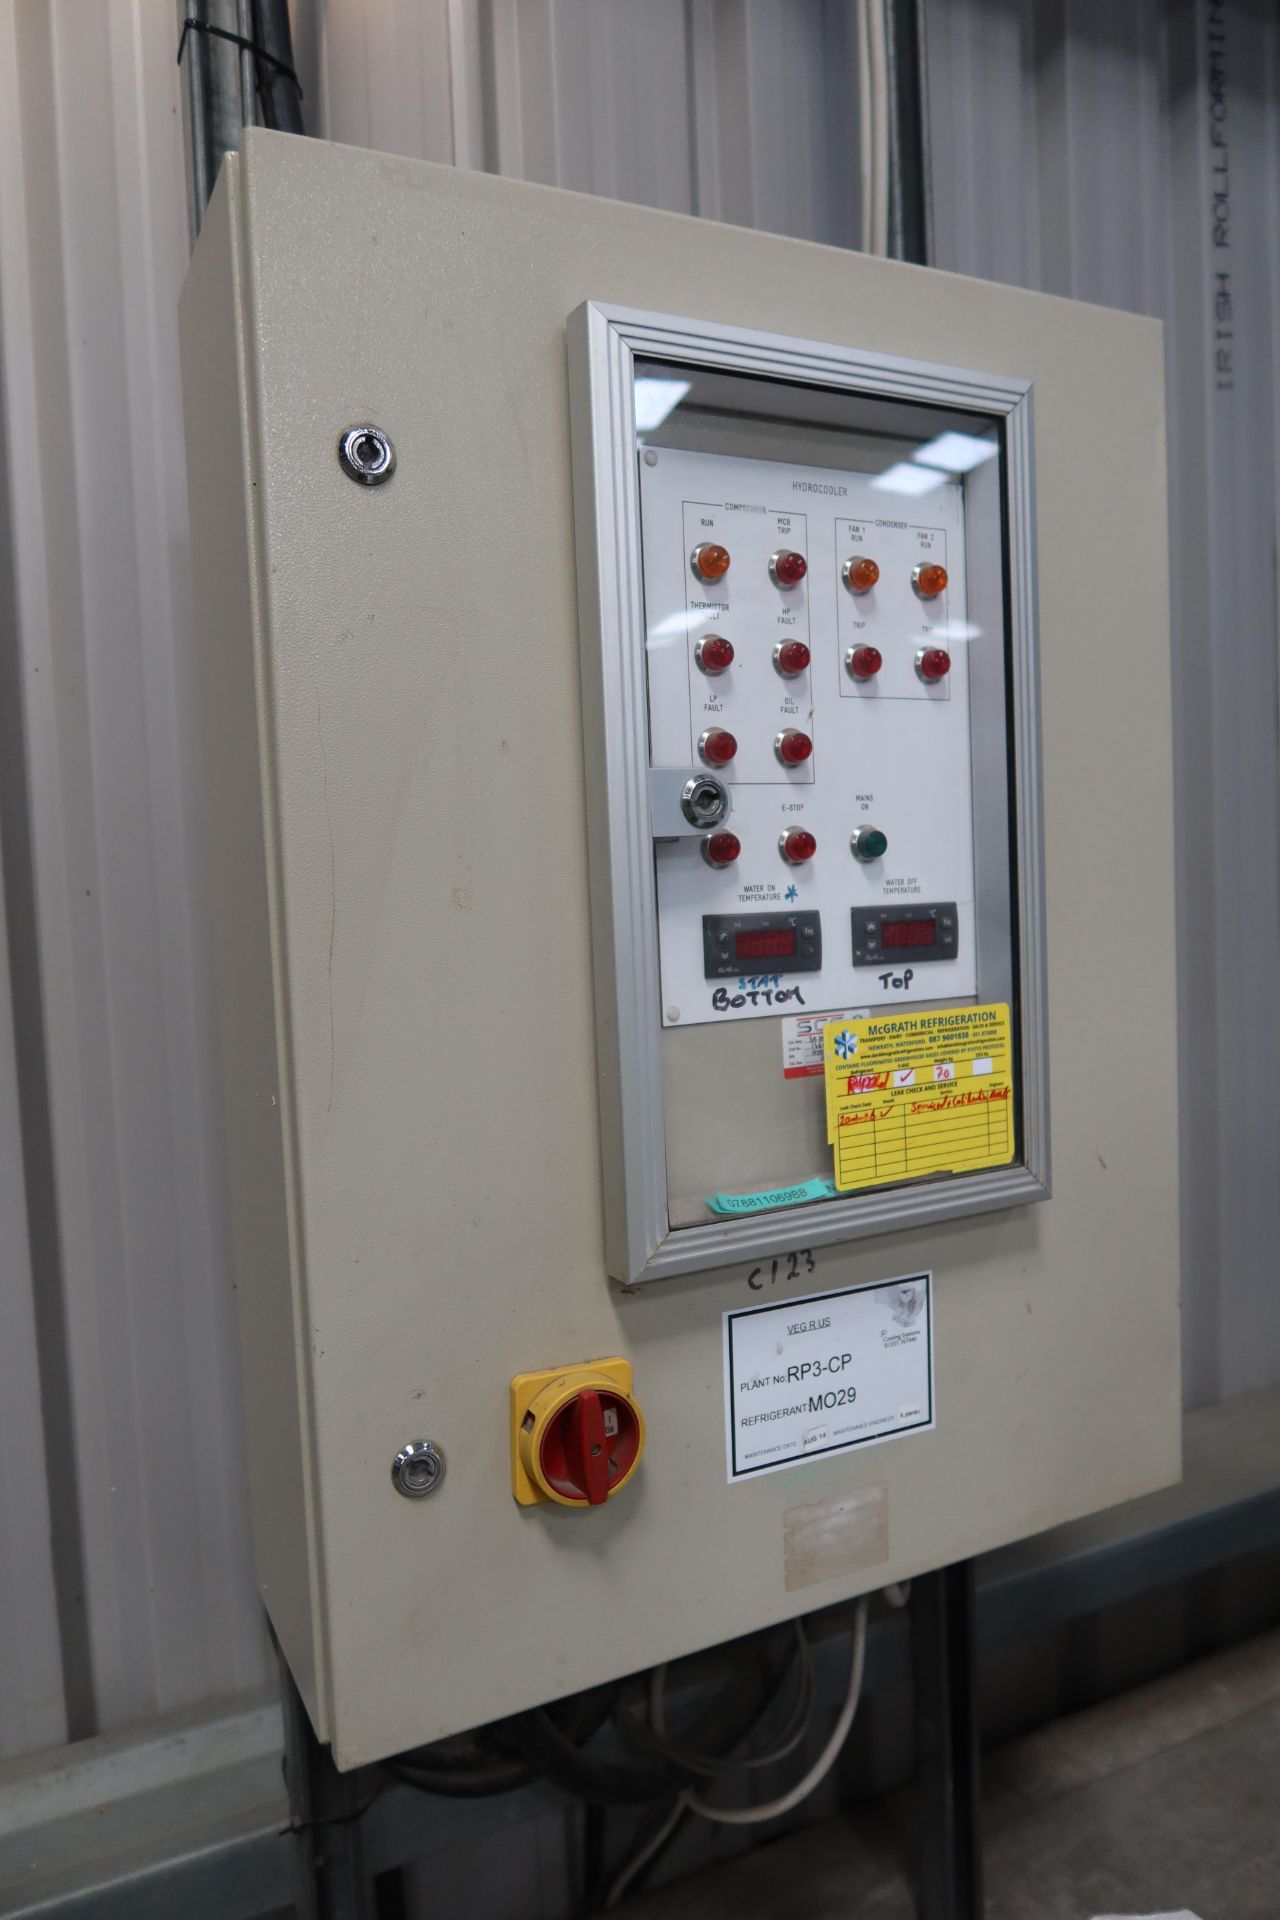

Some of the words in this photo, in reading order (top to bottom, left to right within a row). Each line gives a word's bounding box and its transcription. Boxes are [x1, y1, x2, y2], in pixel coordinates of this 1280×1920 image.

[1214, 271, 1233, 391] IRISH
[792, 480, 848, 497] HYDROCOOLER
[701, 518, 714, 527] RUN
[777, 517, 791, 526] MCB
[875, 518, 908, 529] CONDENSER
[777, 526, 791, 535] TRIP
[848, 524, 860, 533] FAN
[851, 534, 863, 542] RUN
[917, 532, 929, 540] FAN
[920, 541, 932, 549] RUN
[782, 607, 791, 616] HP
[777, 616, 796, 625] FAULT
[853, 621, 866, 629] TRIP
[709, 695, 718, 703] LP
[784, 697, 795, 706] OIL
[704, 703, 724, 712] FAULT
[780, 706, 799, 715] FAULT
[855, 794, 874, 802] MAINS
[781, 803, 805, 812] E-STOP
[885, 879, 904, 887] WATER
[907, 878, 917, 886] OFF
[743, 884, 764, 894] WATER
[767, 883, 776, 892] ON
[883, 886, 921, 896] TEMPERATURE
[738, 892, 781, 903] TEMPERATURE
[868, 1019, 917, 1035] McGRATH
[920, 1010, 996, 1029] REFRIGERATION
[905, 1086, 922, 1094] CHECK
[937, 1081, 957, 1089] SERVICE
[787, 1322, 806, 1335] VEG
[810, 1320, 814, 1330] R
[818, 1316, 830, 1328] US
[740, 1377, 769, 1392] PLANT
[744, 1445, 781, 1459] MAINTENANCE
[803, 1436, 816, 1445] AUG
